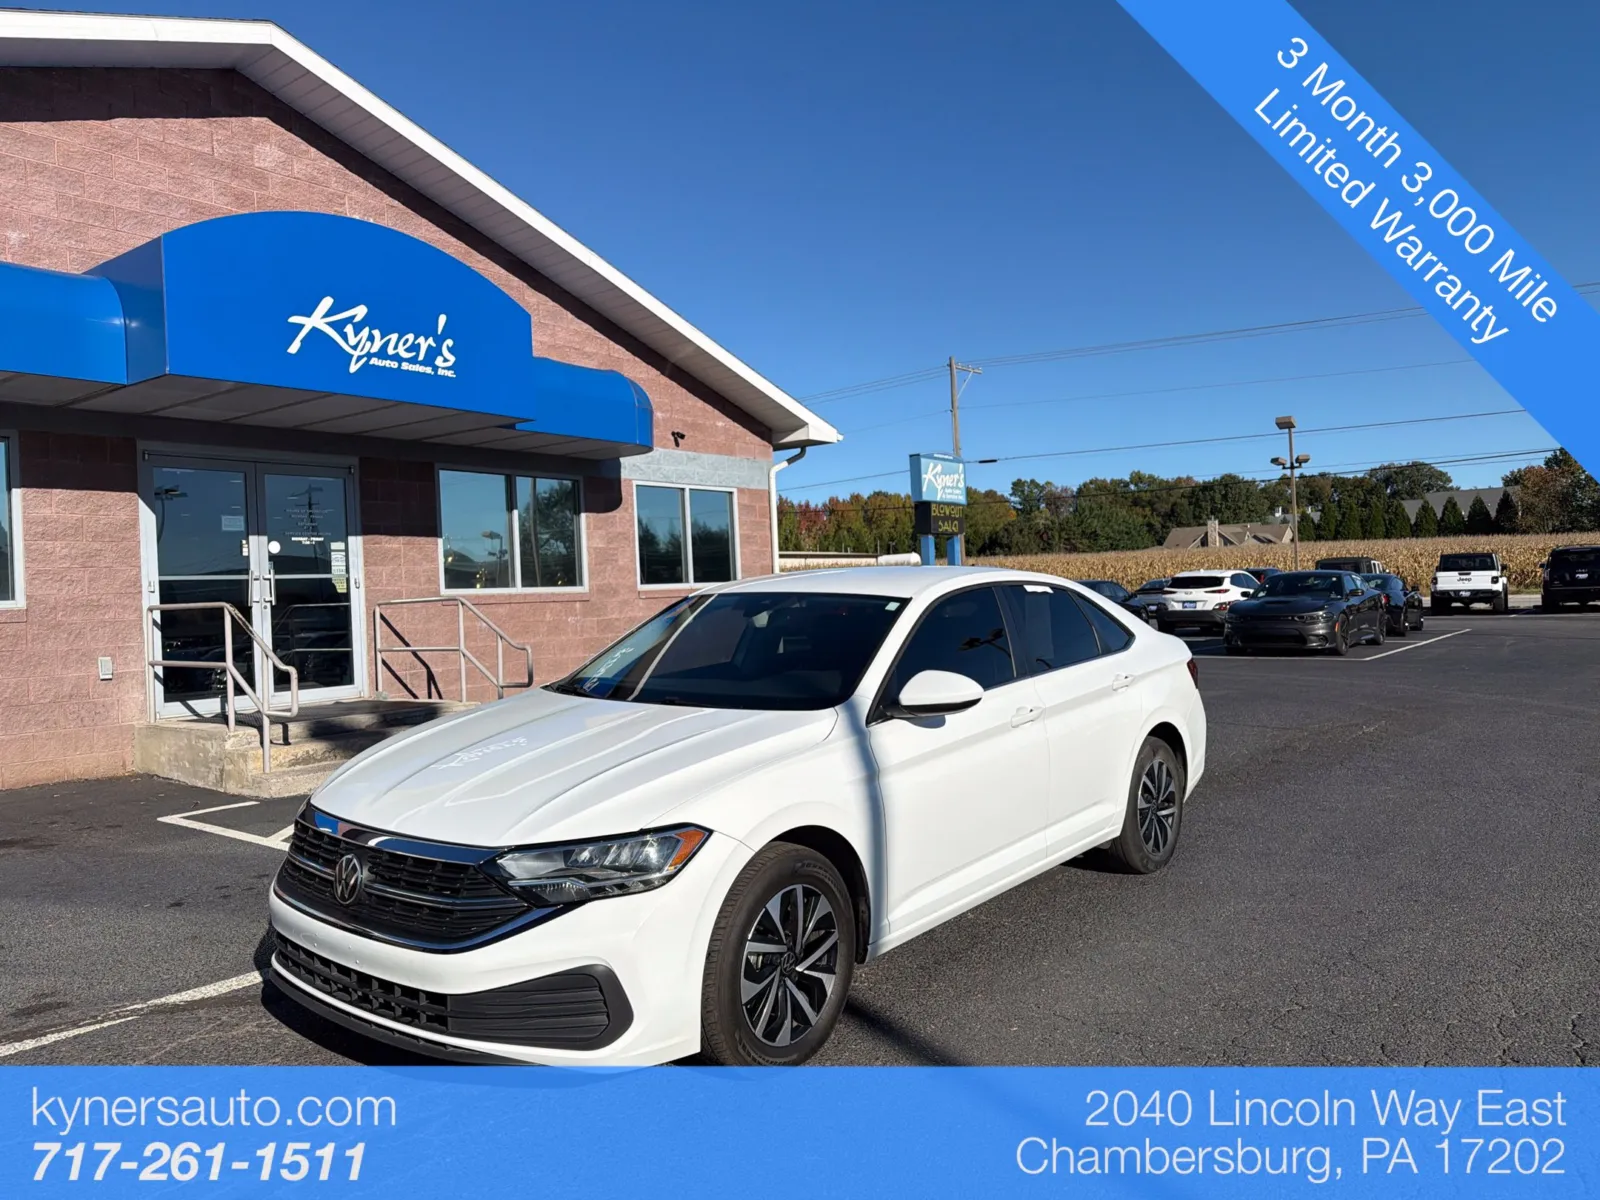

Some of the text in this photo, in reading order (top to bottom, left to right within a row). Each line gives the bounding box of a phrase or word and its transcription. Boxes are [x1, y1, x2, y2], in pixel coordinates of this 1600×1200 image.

[286, 295, 457, 374] Kyner's
[368, 357, 399, 369] Auto
[400, 361, 435, 376] Sales,
[922, 462, 965, 501] Kyner's
[931, 504, 963, 517] BLOWOUT
